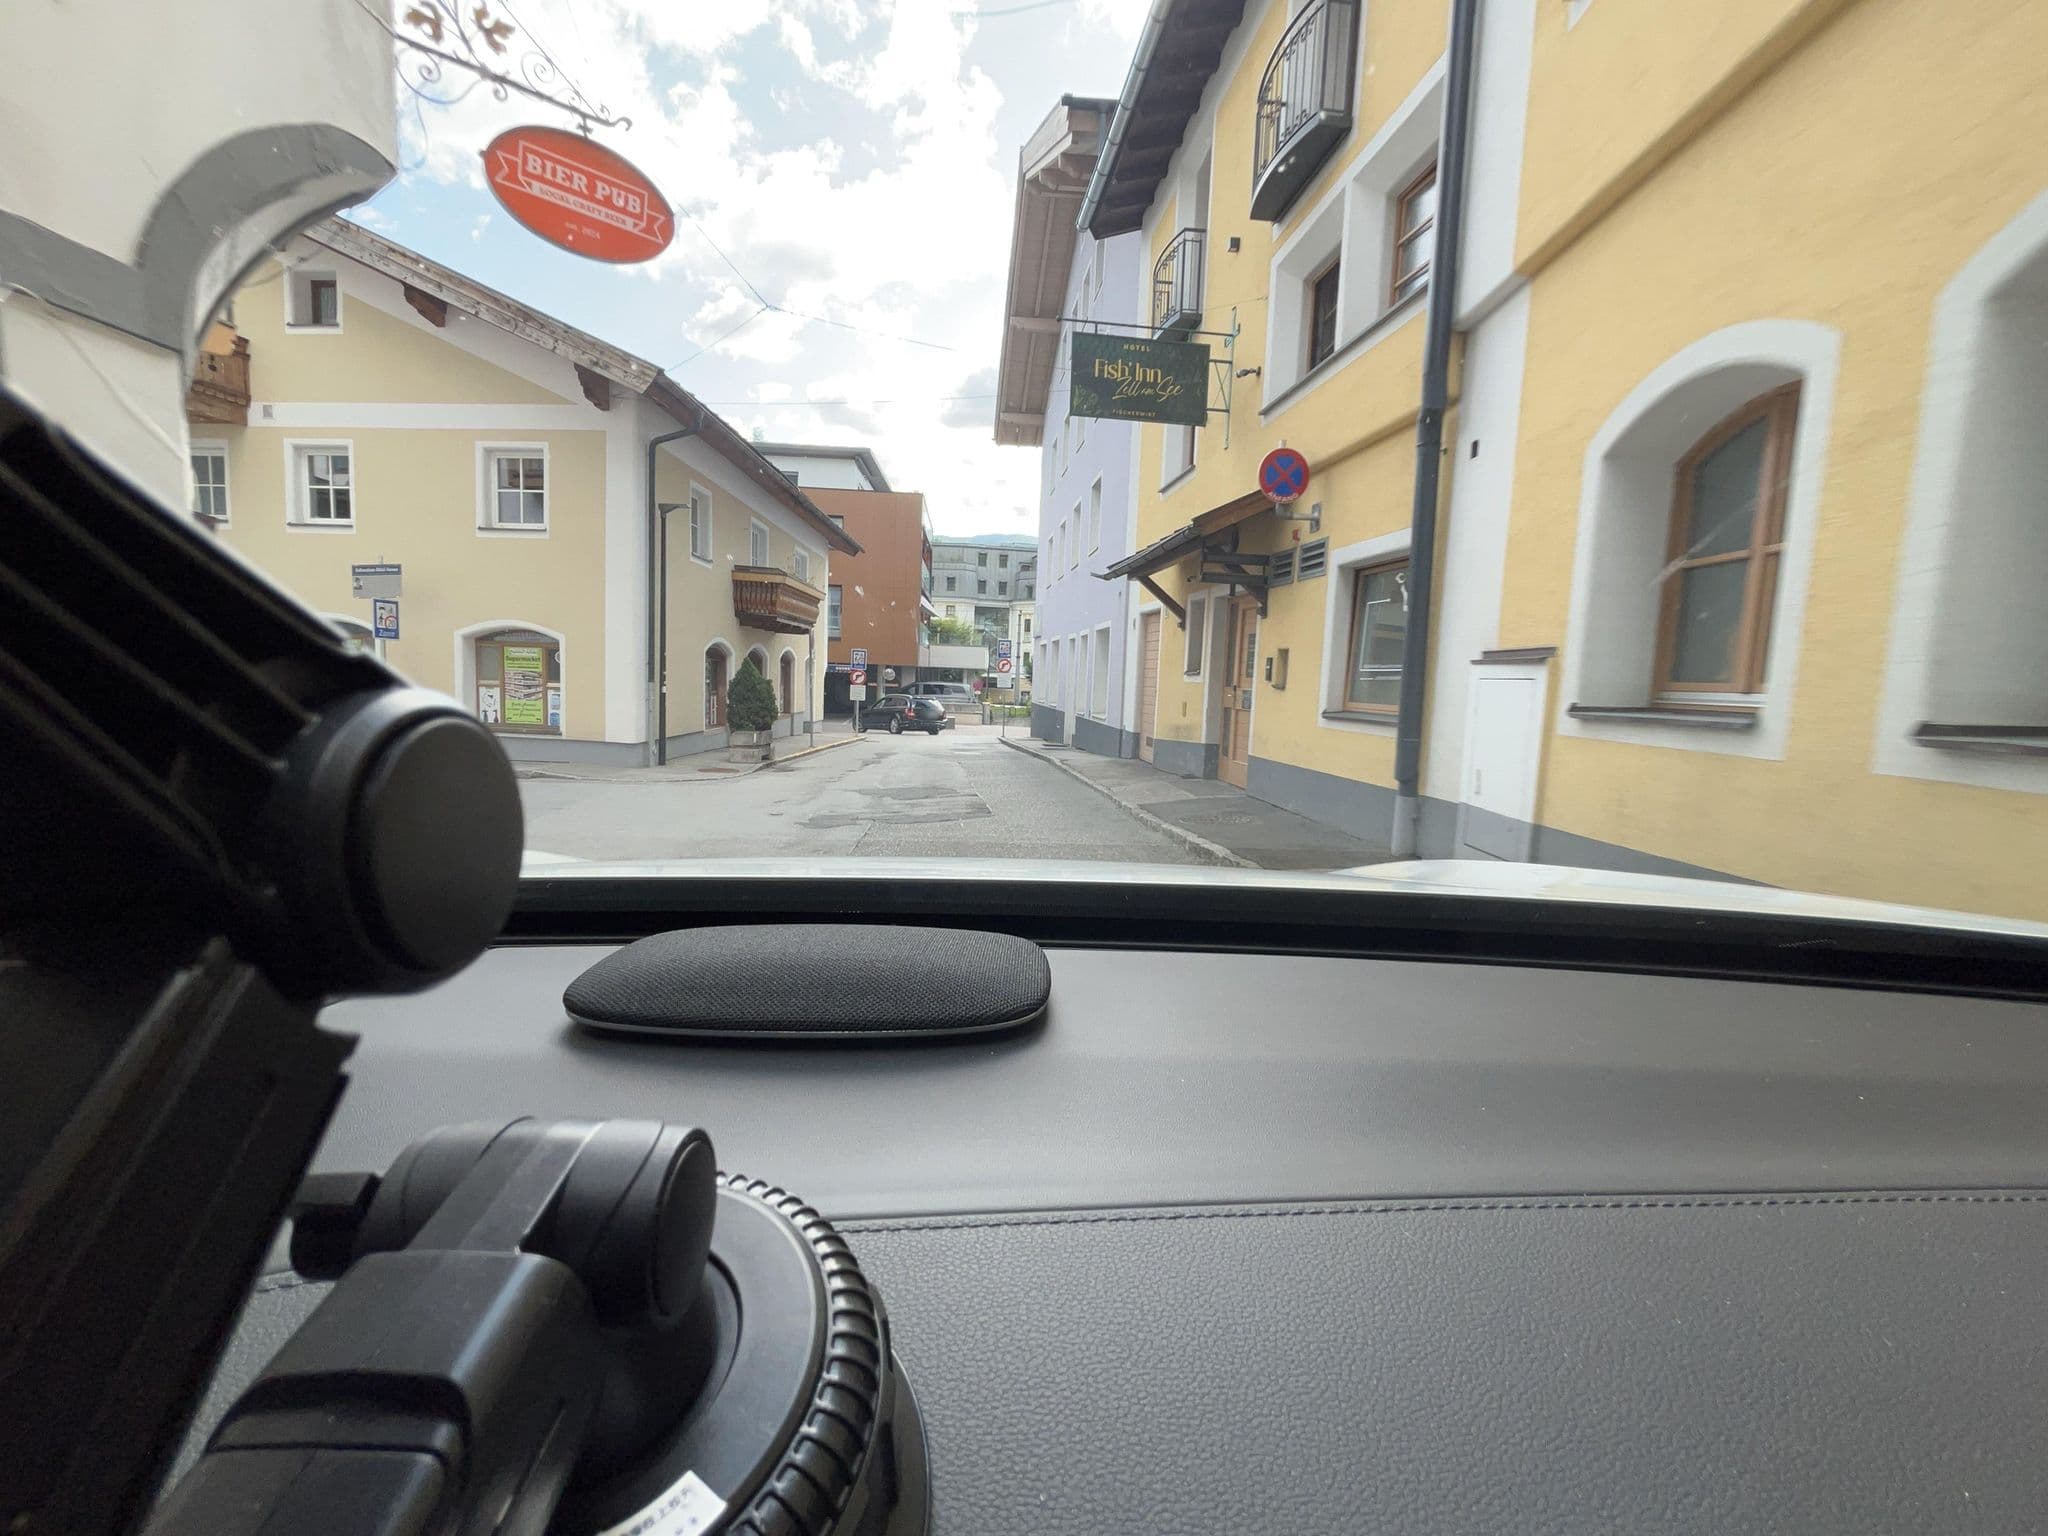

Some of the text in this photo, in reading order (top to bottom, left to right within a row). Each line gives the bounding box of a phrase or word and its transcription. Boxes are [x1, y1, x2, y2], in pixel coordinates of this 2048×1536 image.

[526, 153, 641, 213] BIER PUB
[539, 187, 571, 205] LOCAL
[573, 200, 603, 216] CRAFT
[1123, 344, 1152, 352] HOTEL
[1135, 362, 1162, 383] Inn
[1112, 376, 1141, 400] Zell
[1156, 376, 1185, 402] See
